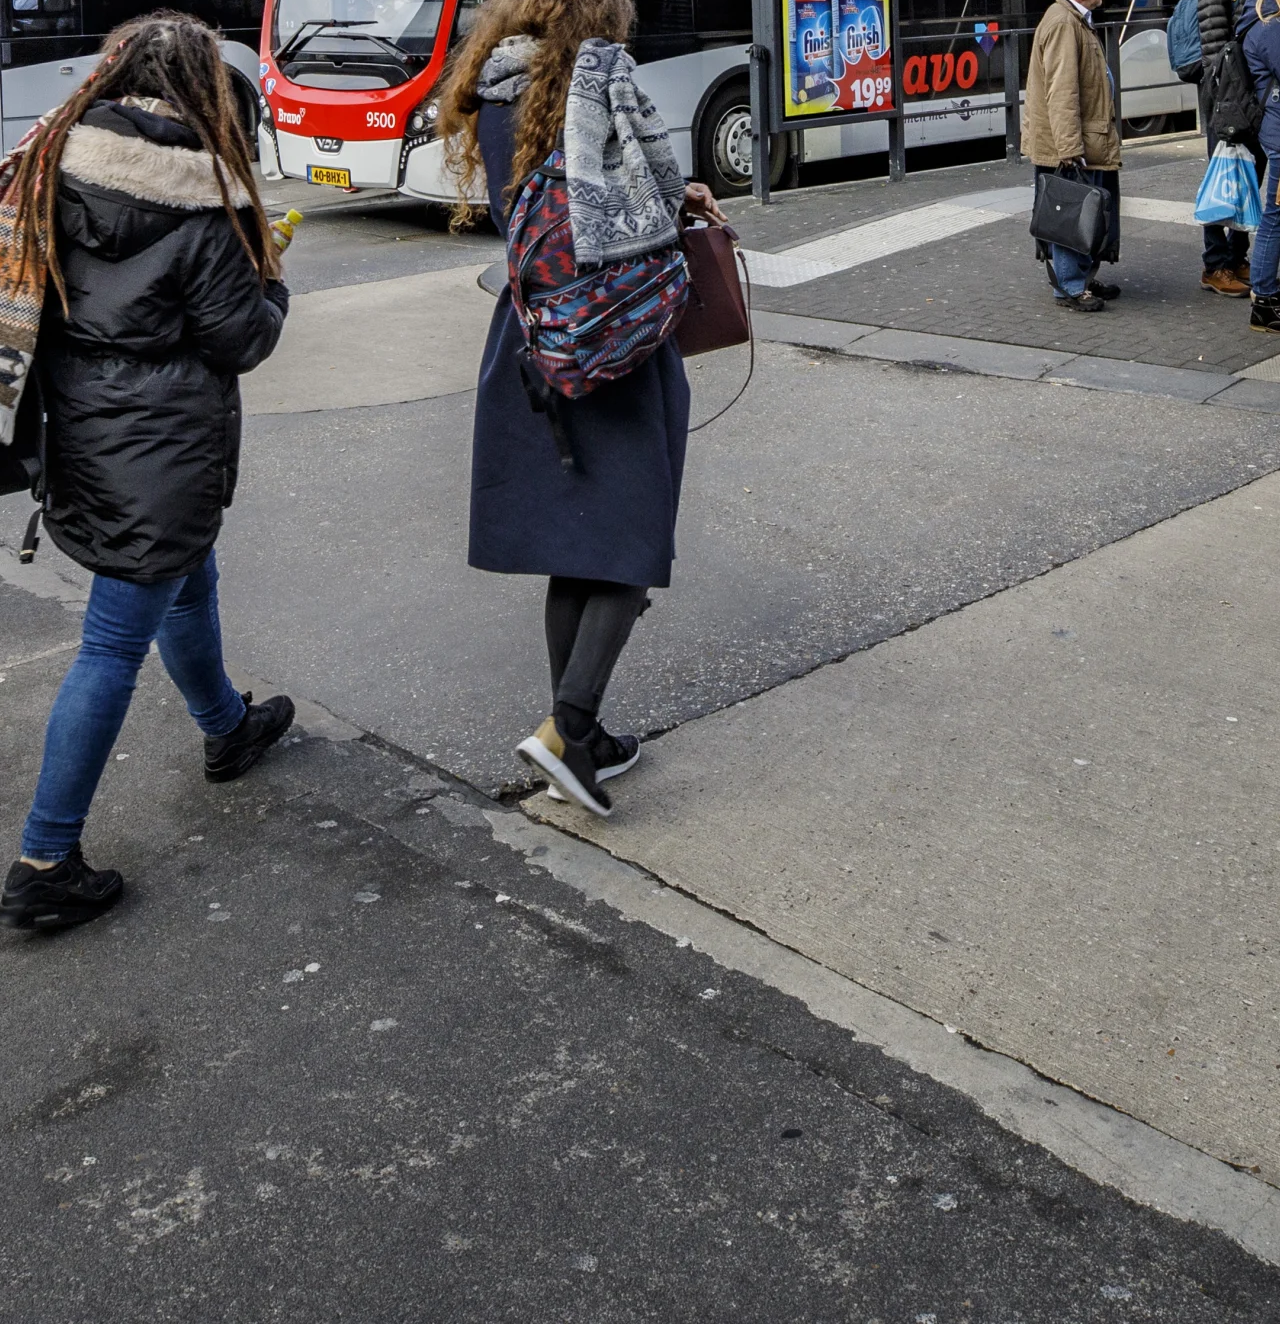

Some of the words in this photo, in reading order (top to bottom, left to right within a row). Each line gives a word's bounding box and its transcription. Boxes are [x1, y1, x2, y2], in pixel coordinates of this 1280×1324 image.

[804, 29, 832, 54] finis
[847, 23, 880, 50] finish
[903, 51, 979, 95] avo
[277, 108, 302, 125] Bravo
[366, 111, 396, 129] 9500
[316, 138, 340, 150] VDL
[313, 169, 347, 185] 40-BHX-1
